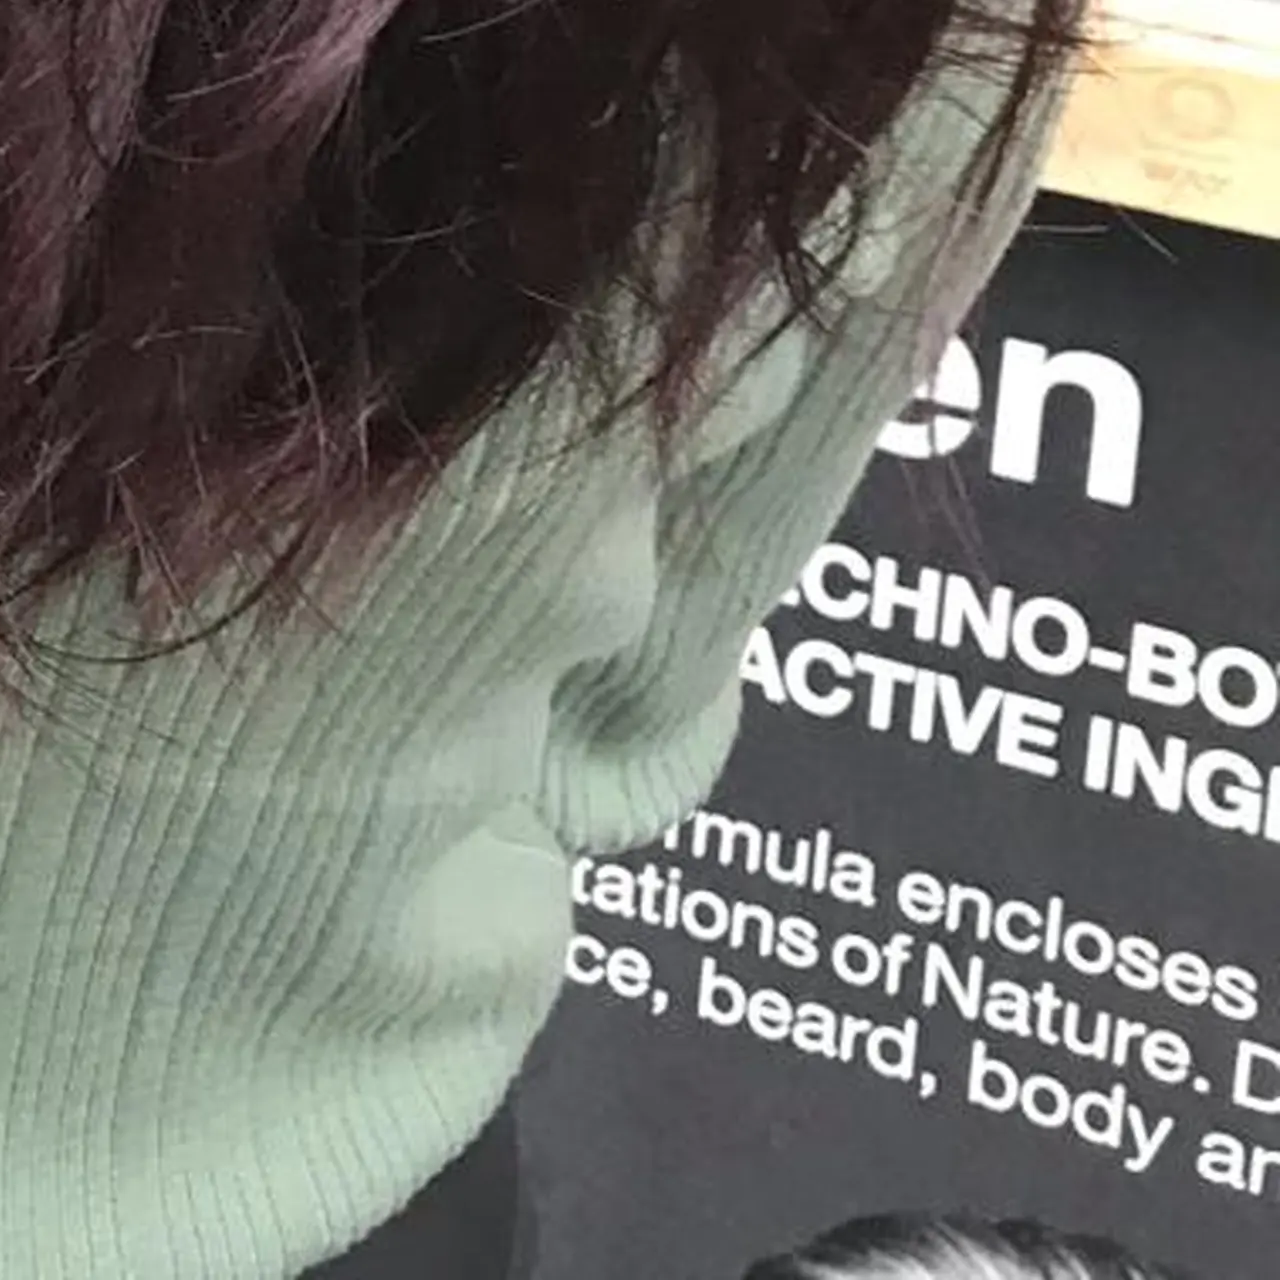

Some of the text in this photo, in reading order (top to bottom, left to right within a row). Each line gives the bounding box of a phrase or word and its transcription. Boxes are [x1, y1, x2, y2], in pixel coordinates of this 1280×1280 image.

[780, 542, 1280, 729] CHNO-BO
[739, 625, 1280, 844] ACTIVE ING
[831, 933, 914, 996] of
[922, 942, 1210, 1094] Nature.
[897, 872, 1258, 1021] encloses
[564, 934, 669, 1015] ce,
[697, 956, 938, 1099] beard,
[967, 1039, 1174, 1173] body
